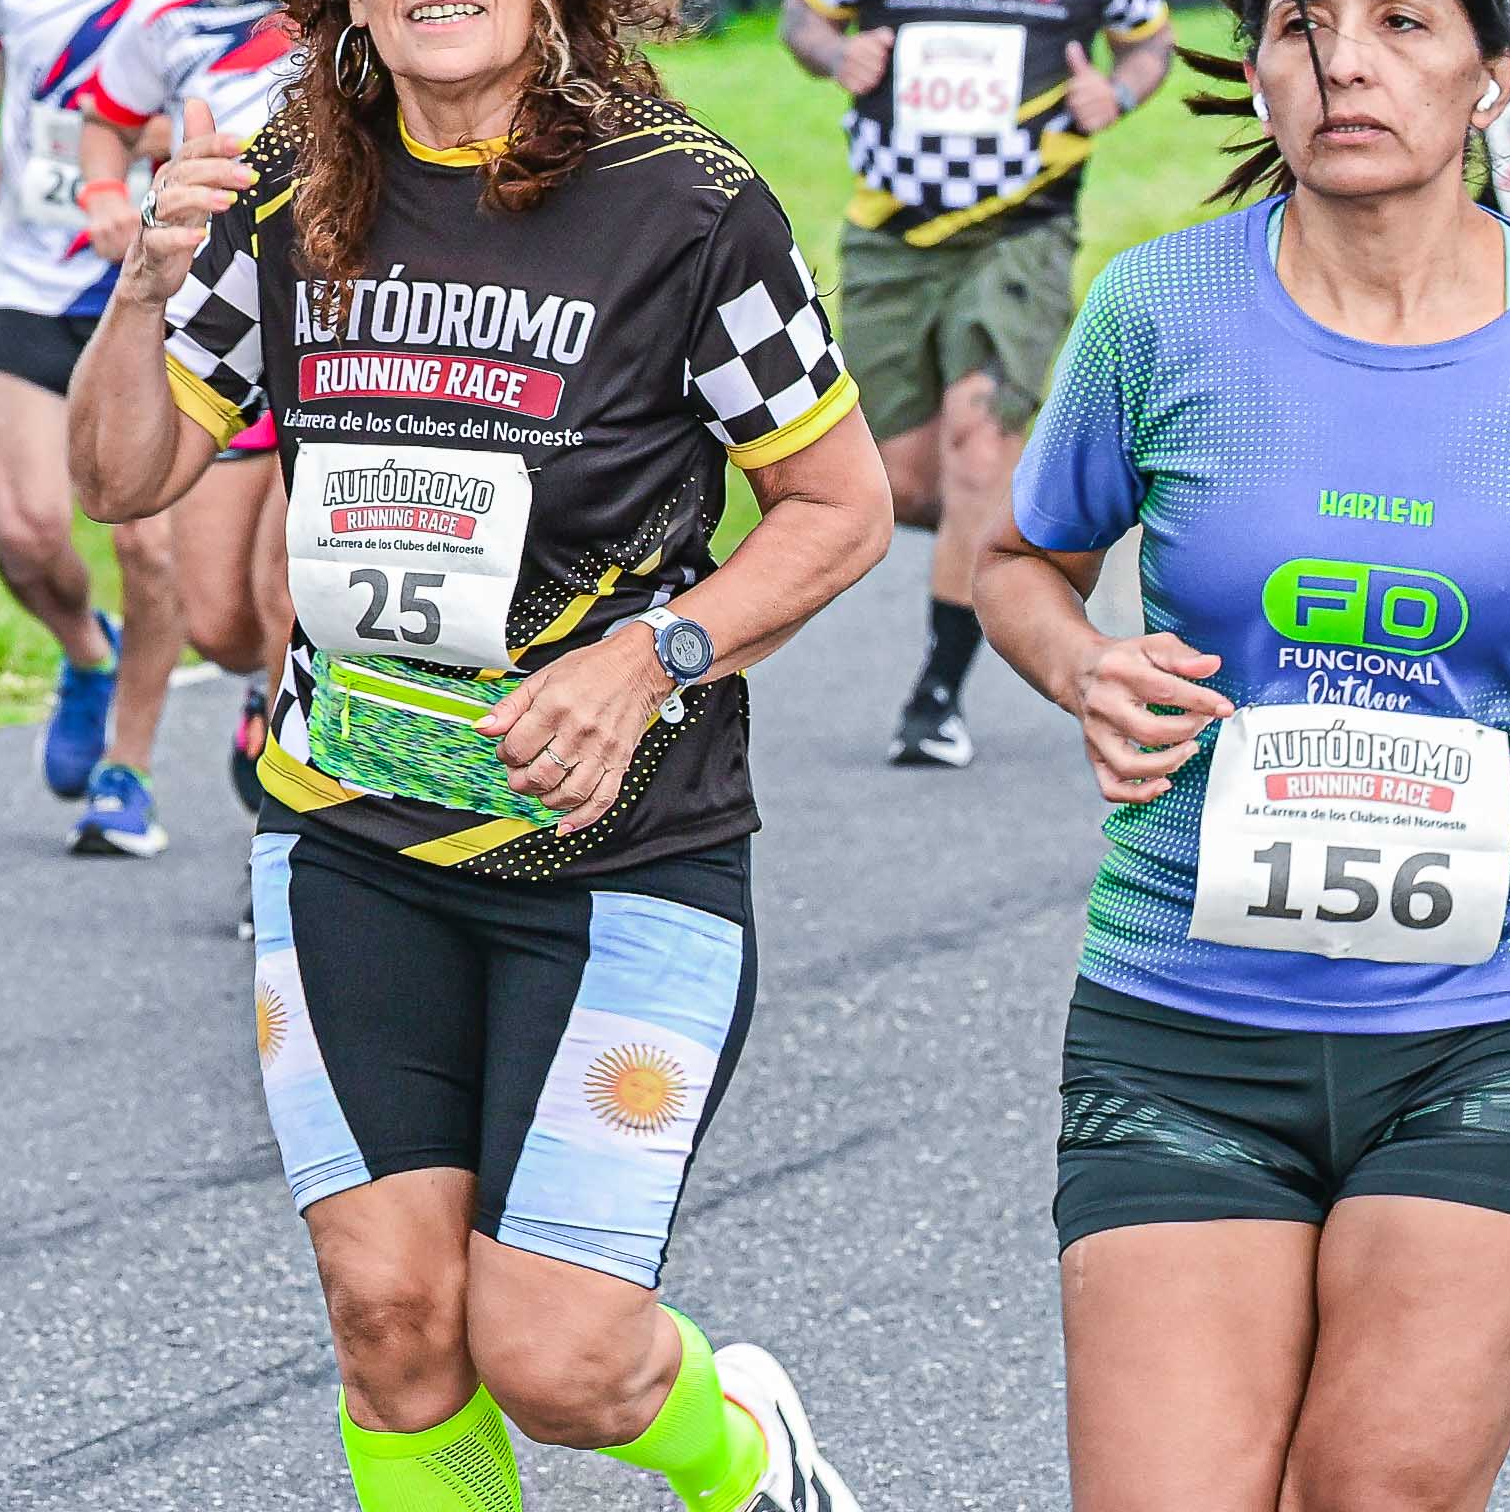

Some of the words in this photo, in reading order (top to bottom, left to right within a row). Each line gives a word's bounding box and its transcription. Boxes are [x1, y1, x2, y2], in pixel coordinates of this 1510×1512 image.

[899, 77, 1010, 115] 4065
[314, 356, 442, 395] RUNNING
[443, 360, 528, 408] RACE
[339, 410, 362, 431] de
[365, 411, 392, 433] los
[395, 414, 456, 437] Clubes
[459, 418, 489, 440] del
[493, 421, 584, 447] Noroeste
[323, 458, 495, 515] AUTÓDROMO
[346, 508, 415, 530] RUNNING
[417, 511, 461, 535] RACE
[1318, 489, 1435, 528] HARLEM
[317, 536, 328, 547] La
[329, 537, 363, 548] Carrera
[364, 538, 377, 549] de
[378, 538, 392, 550] los
[393, 539, 425, 551] Clubes
[426, 540, 441, 552] del
[442, 542, 484, 555] Noroeste
[348, 568, 446, 645] 25
[1278, 647, 1441, 686] FUNCIONAL
[1306, 670, 1411, 710] Outdoor
[1254, 719, 1471, 784] AUTÓDROMO
[1286, 774, 1375, 798] RUNNING
[1380, 779, 1432, 807] RACE
[1245, 804, 1259, 816] La
[1262, 805, 1307, 818] Carrera
[1310, 808, 1326, 820] de
[1329, 809, 1346, 821] los
[1349, 811, 1389, 824] Clubes
[1392, 813, 1412, 825] del
[1414, 815, 1467, 831] Noroeste
[1246, 841, 1453, 930] 156
